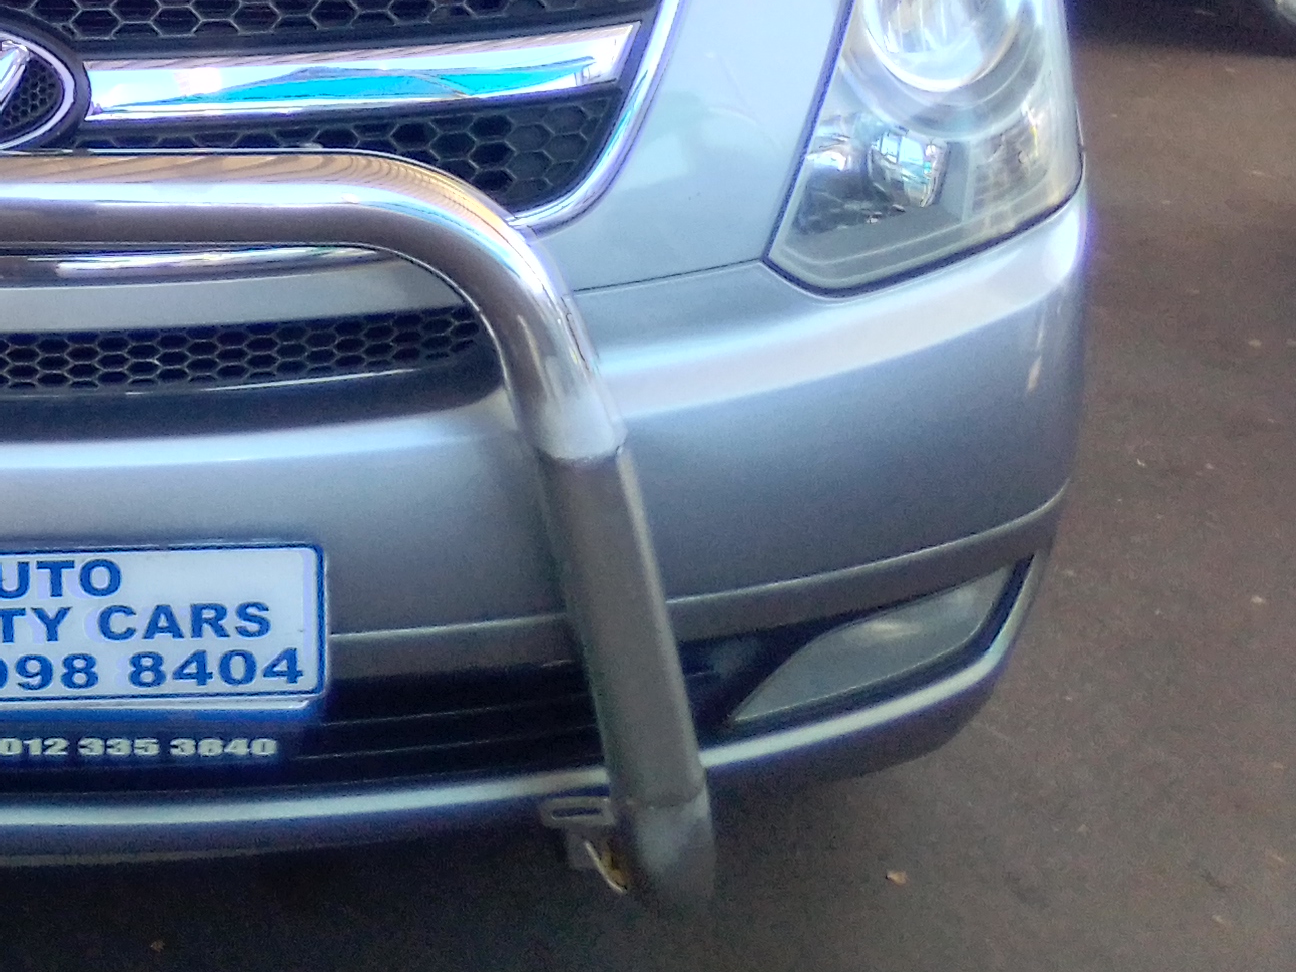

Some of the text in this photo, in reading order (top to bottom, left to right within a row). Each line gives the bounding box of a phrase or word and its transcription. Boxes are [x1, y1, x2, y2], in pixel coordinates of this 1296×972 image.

[97, 602, 272, 641] CARS
[128, 647, 304, 689] 8404
[78, 738, 160, 756] 335
